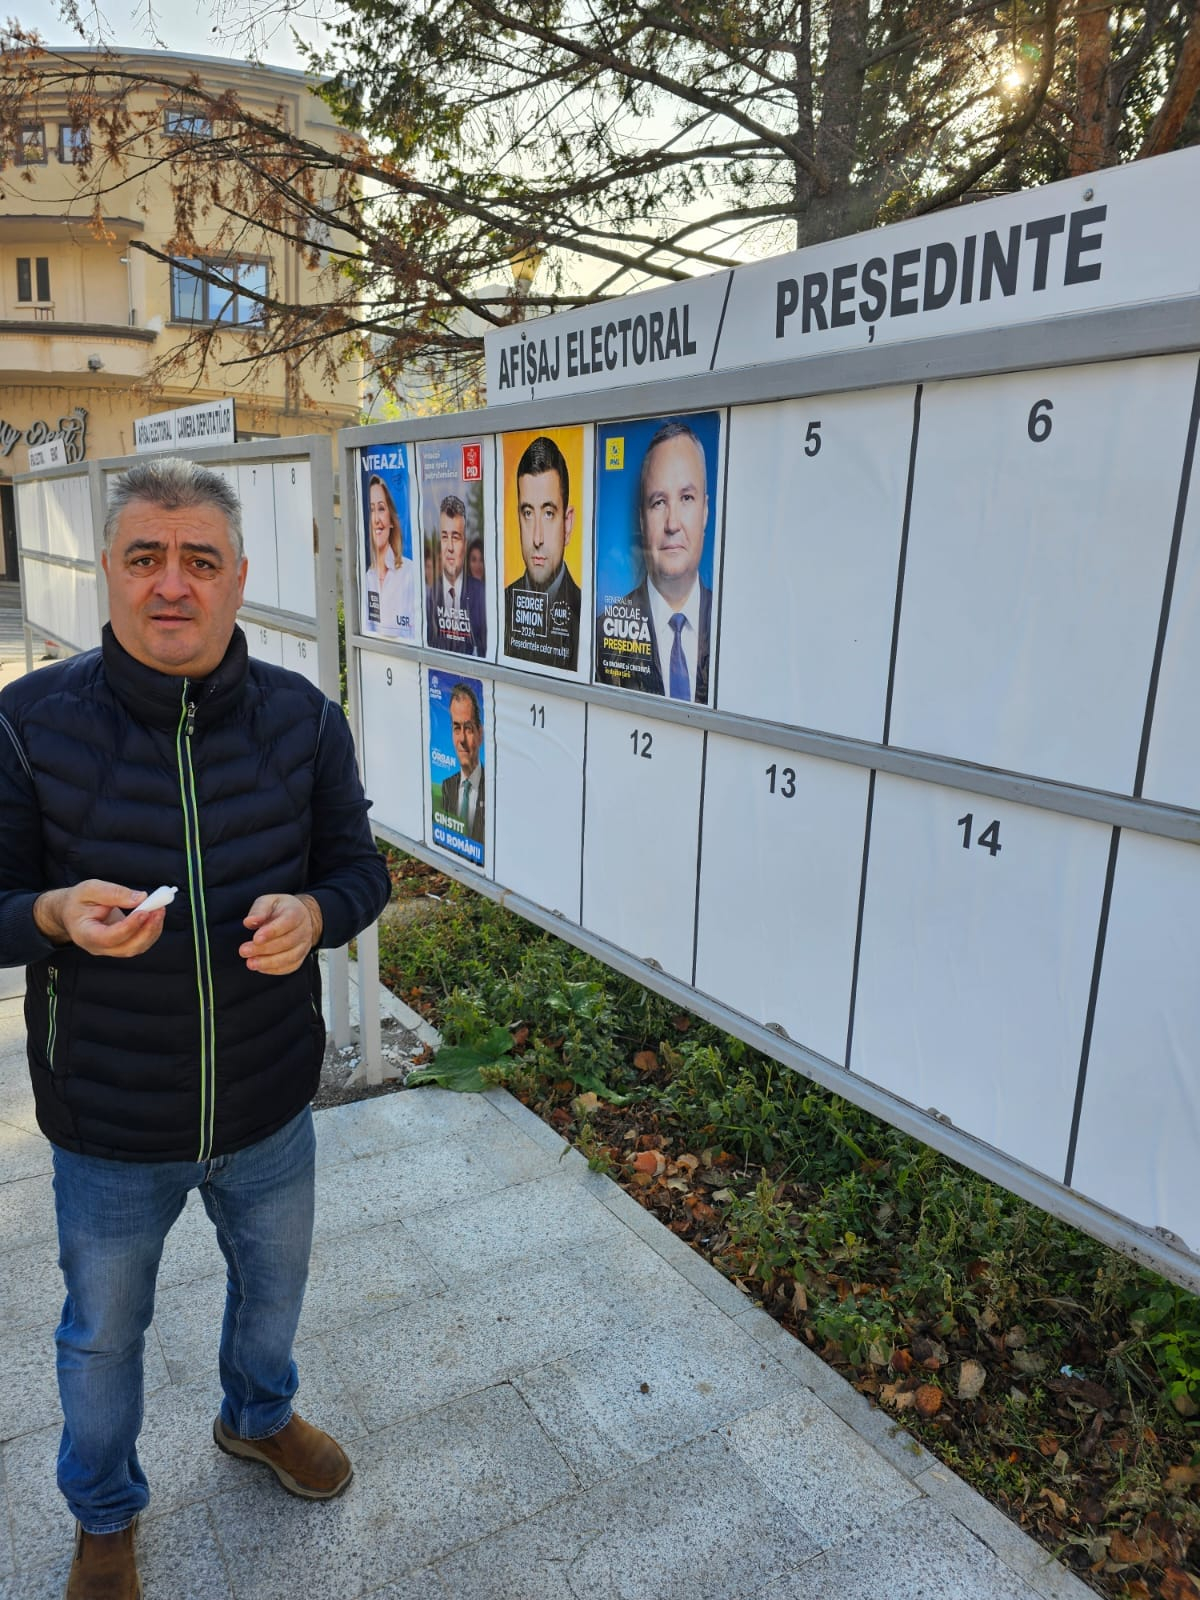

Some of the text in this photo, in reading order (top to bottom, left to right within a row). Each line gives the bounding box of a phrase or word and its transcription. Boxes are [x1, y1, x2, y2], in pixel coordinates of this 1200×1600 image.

[776, 205, 1107, 343] PREȘEDINTE
[499, 304, 696, 400] AFIȘAJ ELECTORAL
[1027, 399, 1054, 443] 6
[804, 421, 822, 457] 5
[290, 467, 296, 485] 8
[516, 595, 544, 611] GEORGE
[604, 604, 641, 620] NICOLAE
[396, 615, 410, 626] USR
[515, 609, 543, 627] SIMION
[554, 607, 567, 618] AUR
[259, 629, 268, 645] 15
[521, 626, 536, 638] 2024
[603, 616, 651, 642] CIUCĂ
[297, 641, 307, 659] 16
[603, 637, 652, 655] PREȘEDINTE
[386, 667, 393, 686] 9
[530, 703, 546, 729] 11
[629, 729, 653, 759] 12
[765, 764, 796, 798] 13
[434, 828, 445, 842] CU
[957, 813, 1002, 857] 14
